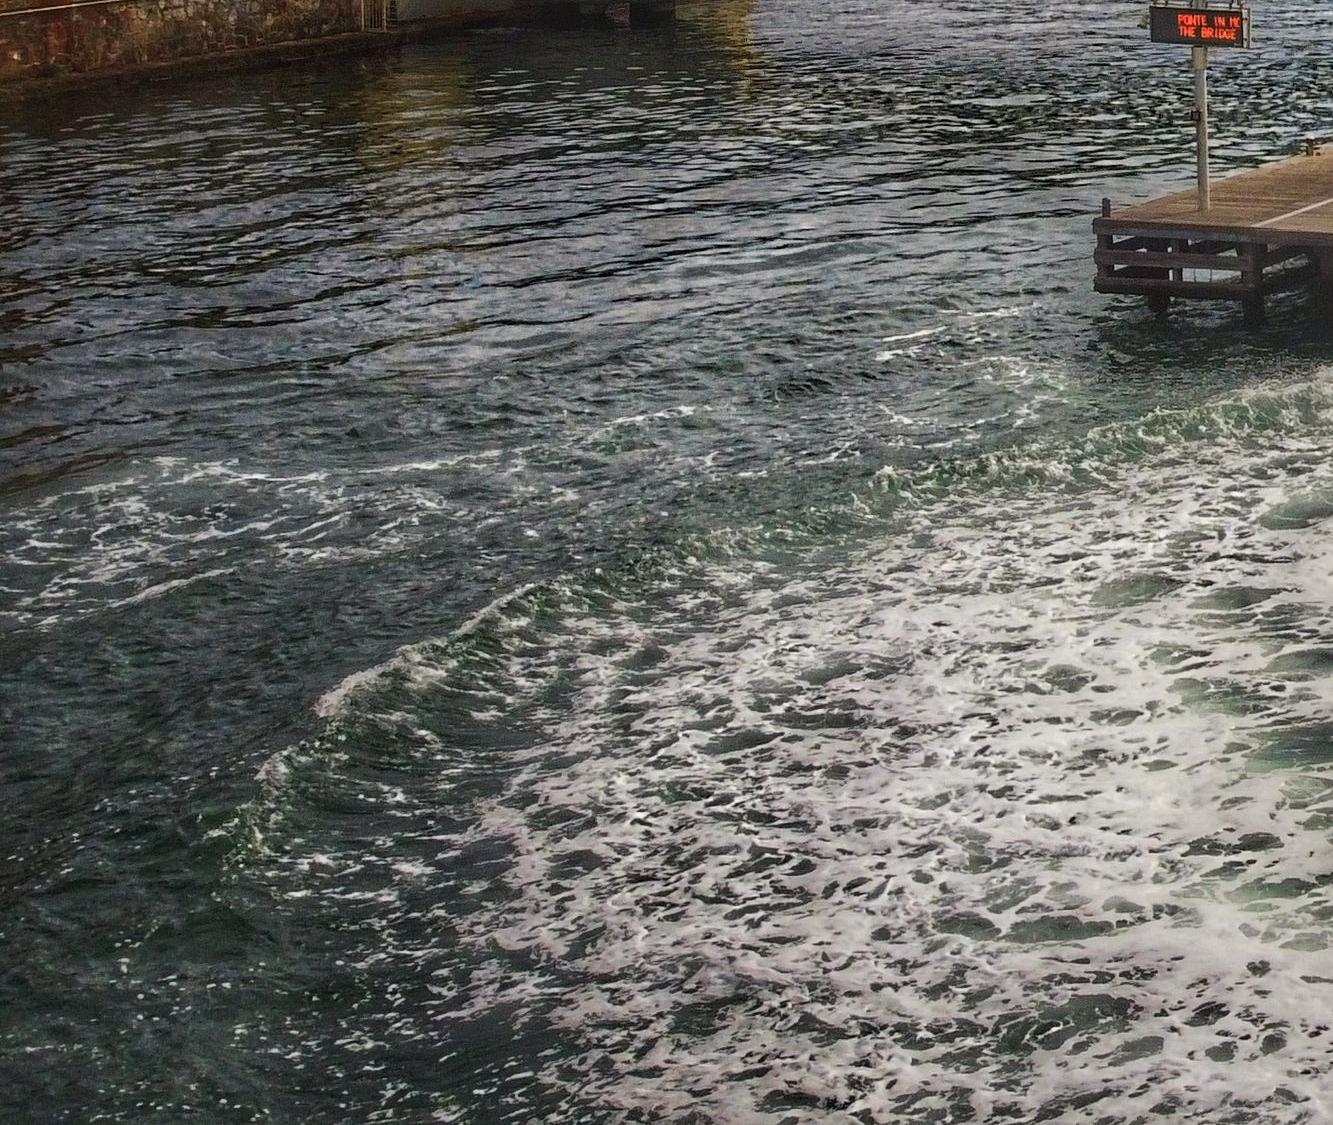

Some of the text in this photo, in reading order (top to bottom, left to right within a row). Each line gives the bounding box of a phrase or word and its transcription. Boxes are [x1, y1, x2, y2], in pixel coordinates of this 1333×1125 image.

[1177, 14, 1207, 26] PONTE
[1214, 16, 1225, 27] IN
[1179, 26, 1237, 40] THE BRIDGE
